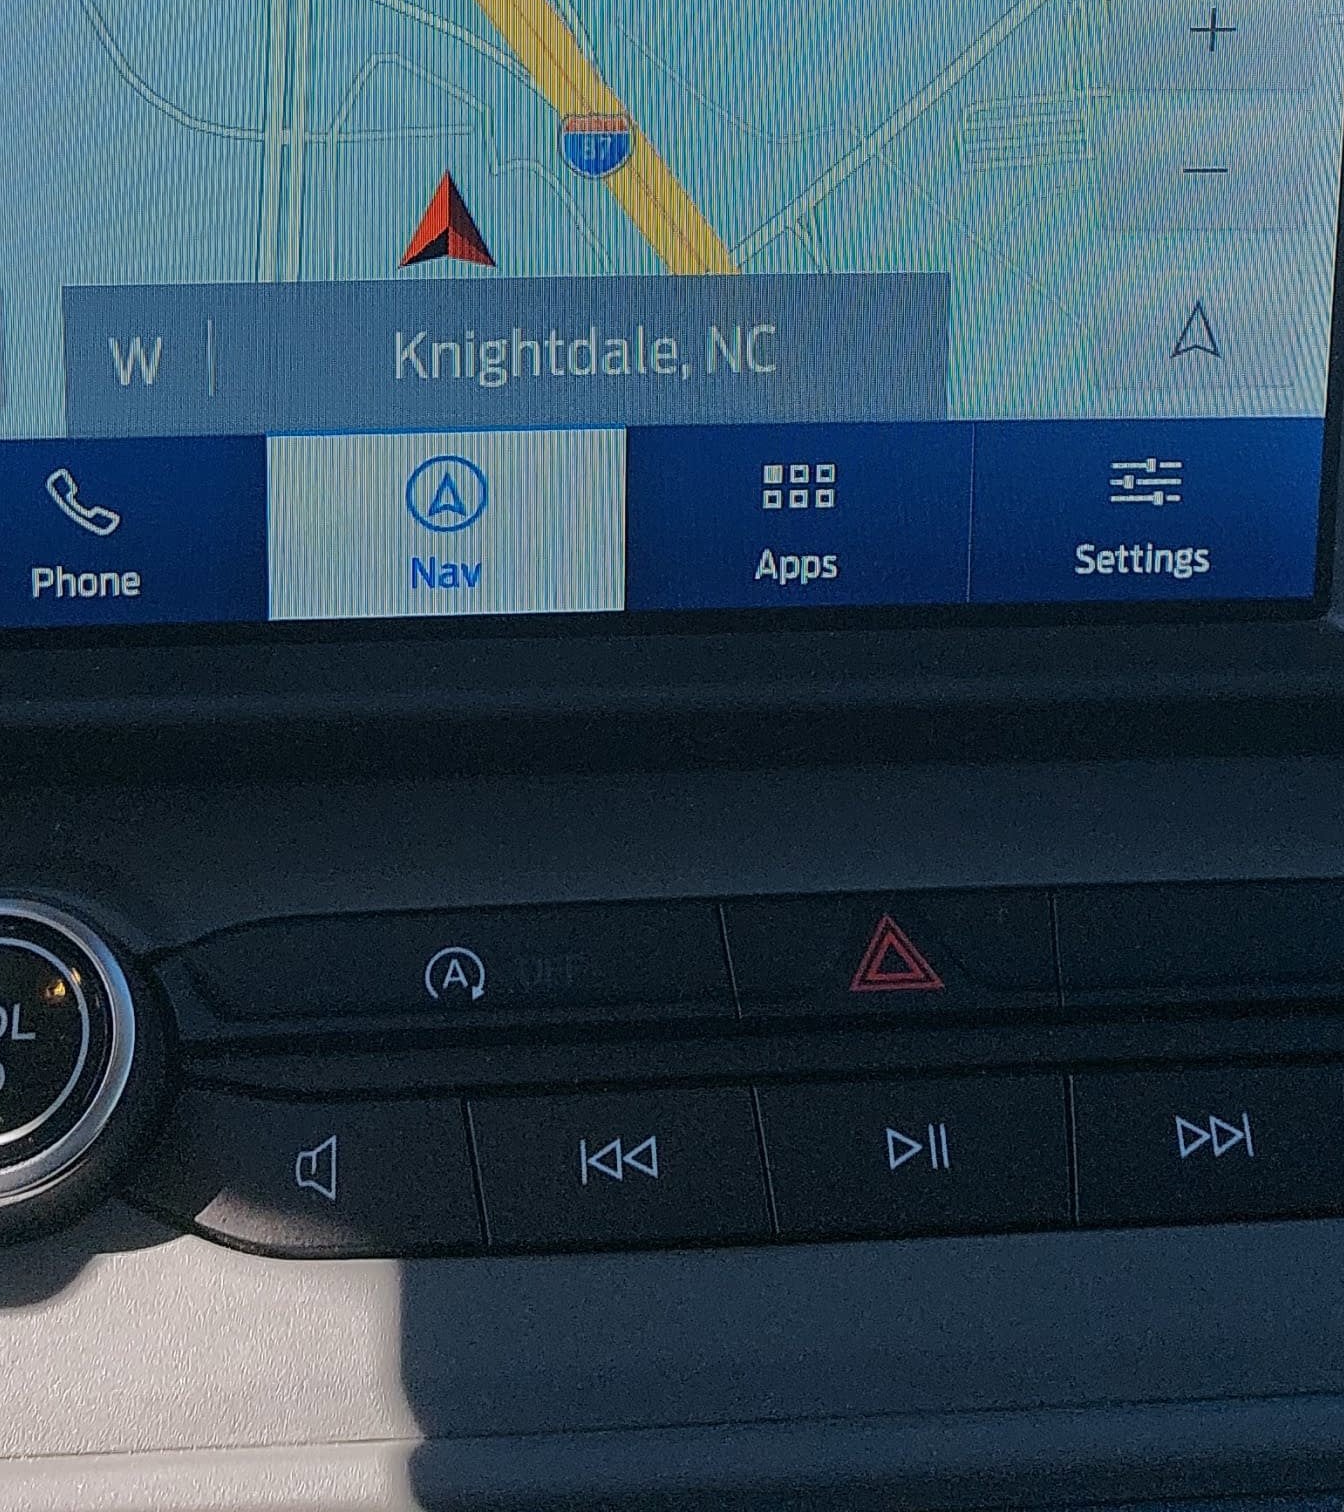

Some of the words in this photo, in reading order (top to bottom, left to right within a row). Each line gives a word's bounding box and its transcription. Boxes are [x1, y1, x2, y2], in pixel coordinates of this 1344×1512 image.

[109, 336, 162, 386] W
[394, 326, 691, 388] Knightdale,
[706, 323, 777, 374] NC
[410, 557, 483, 590] Nav
[754, 548, 839, 586] Apps
[1074, 542, 1211, 580] Settings
[32, 565, 141, 599] Phone
